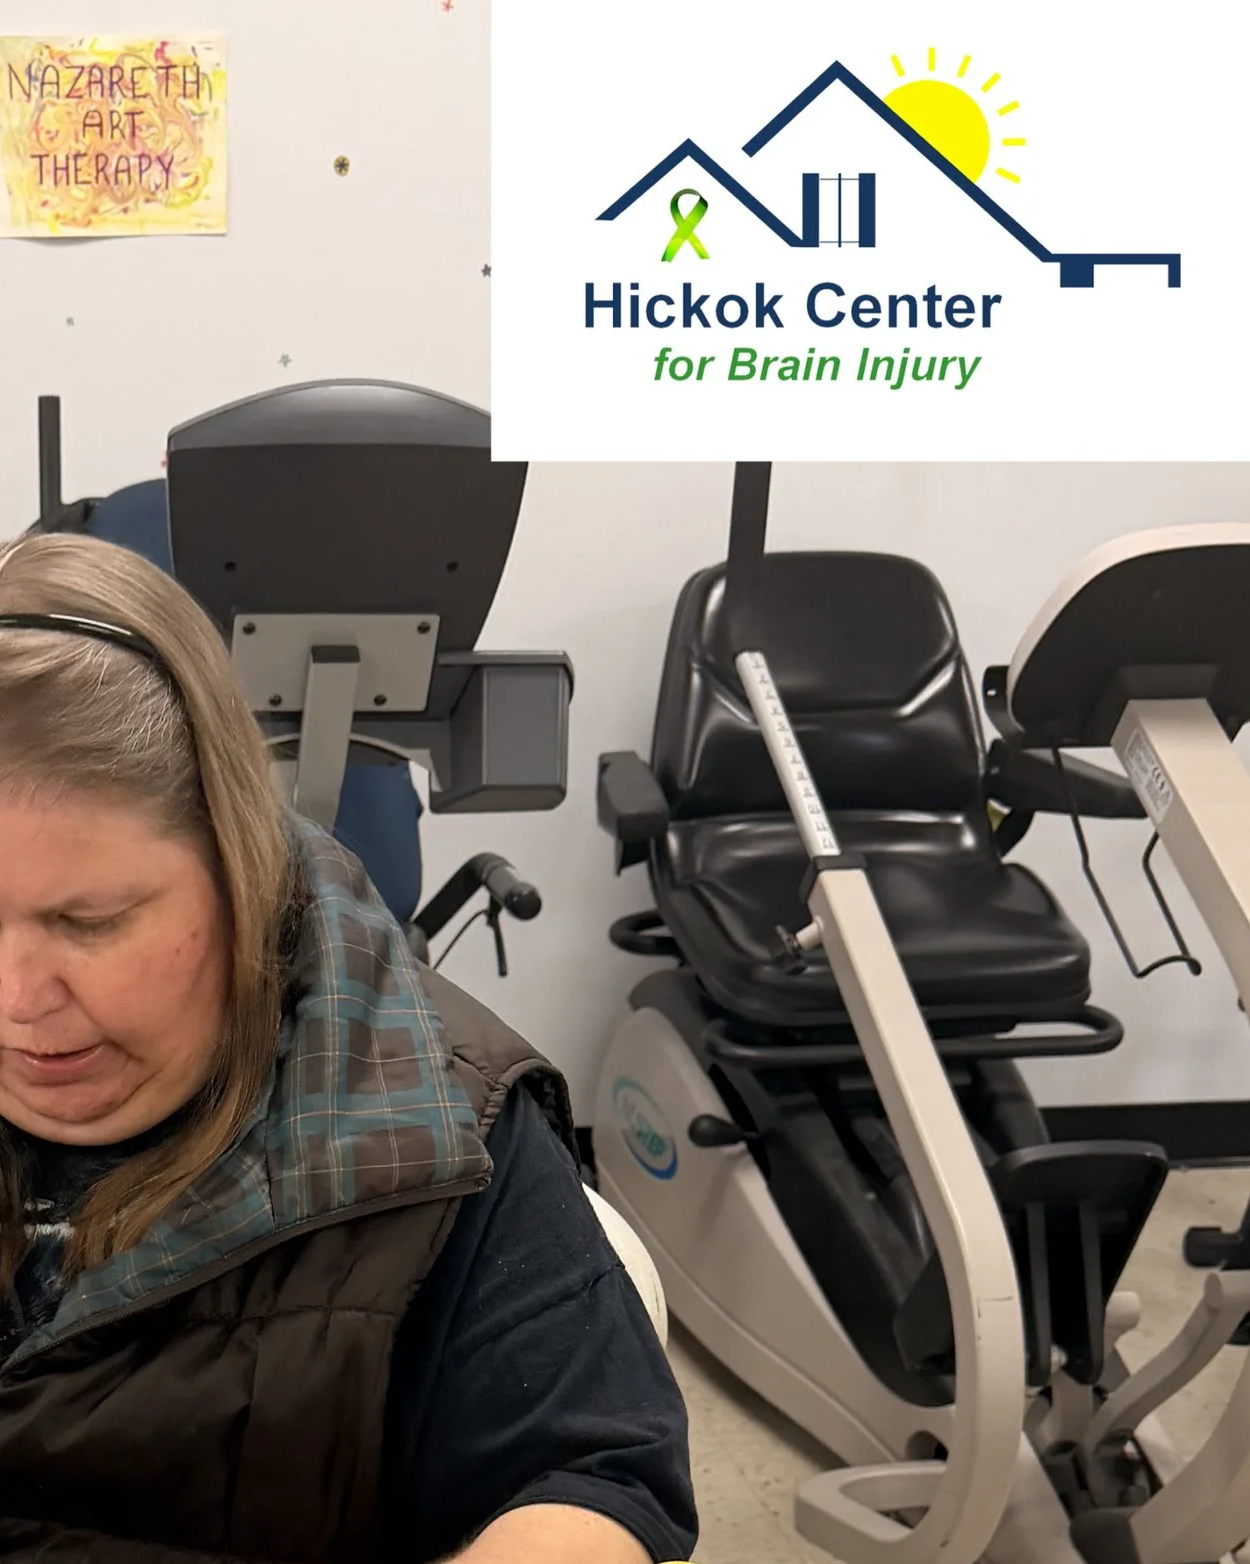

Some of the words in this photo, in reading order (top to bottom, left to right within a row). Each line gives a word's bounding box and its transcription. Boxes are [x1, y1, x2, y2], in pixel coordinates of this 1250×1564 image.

[7, 62, 201, 102] NAZARETH
[82, 110, 144, 140] ART
[30, 152, 175, 190] THERAPY
